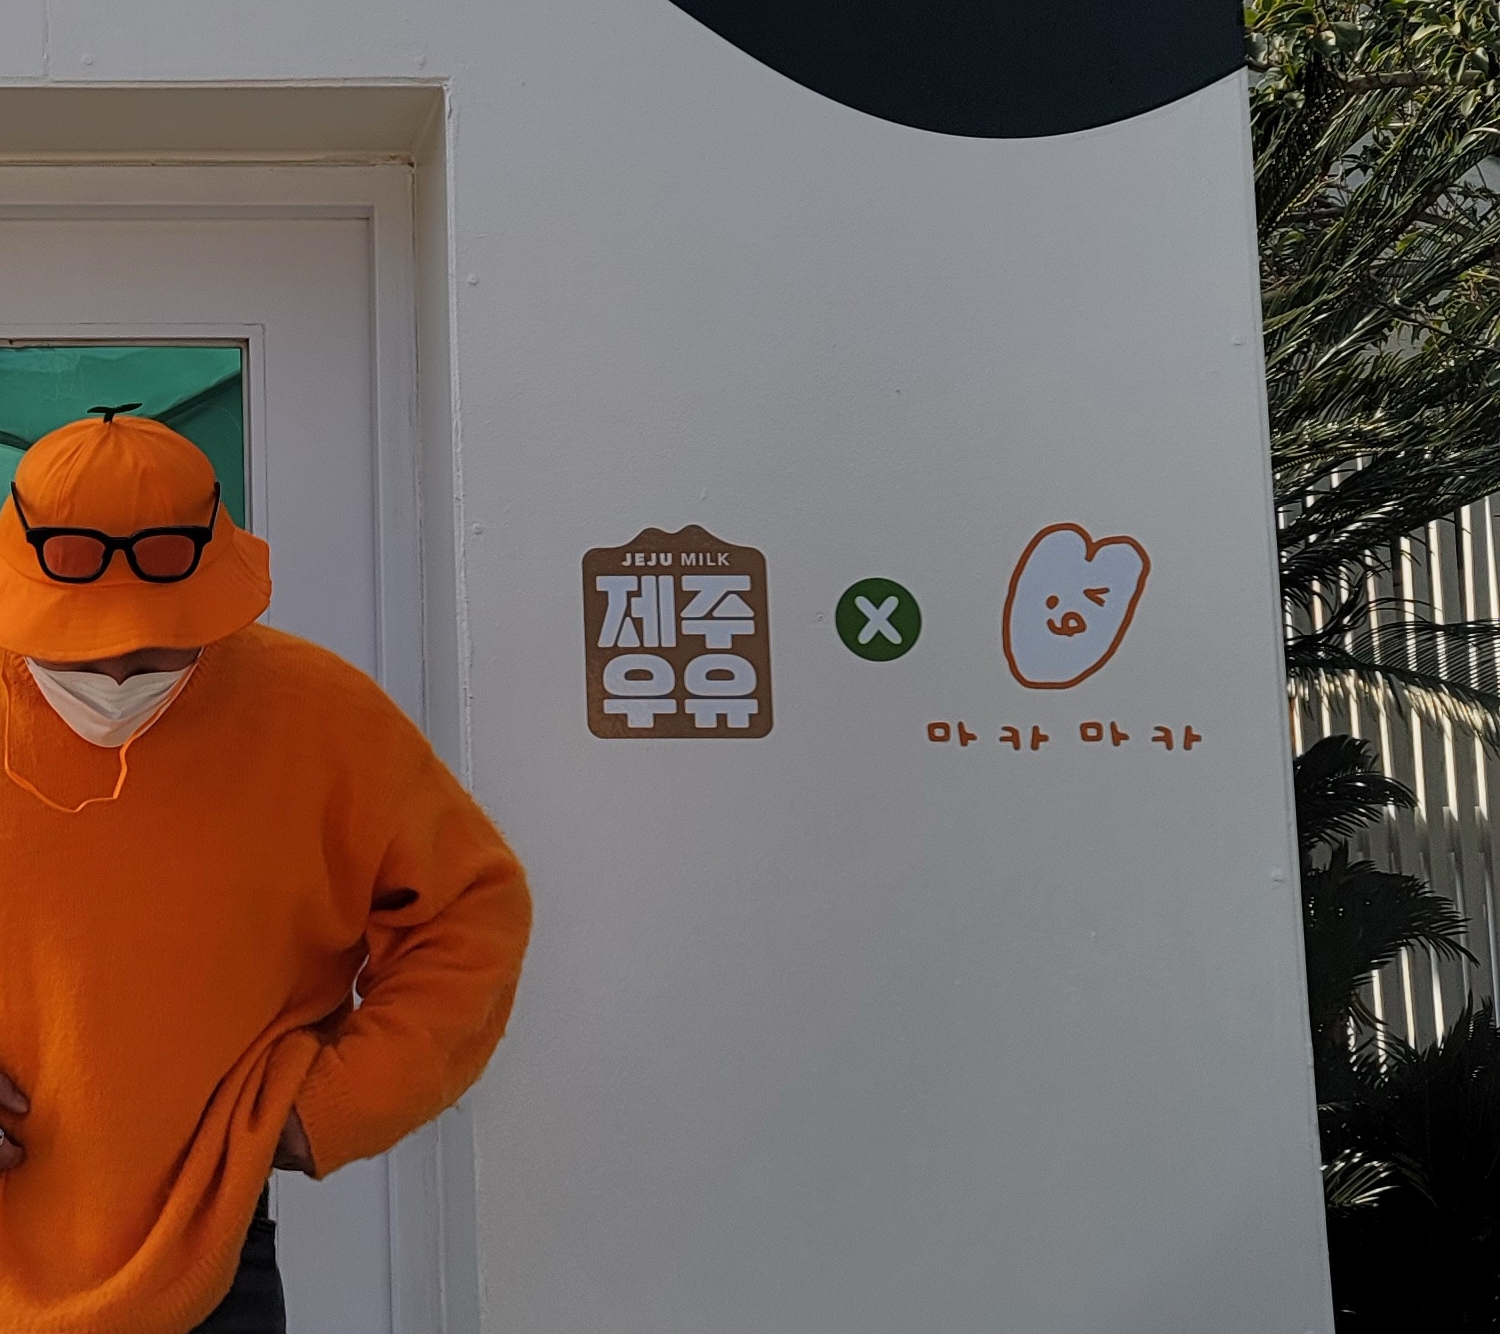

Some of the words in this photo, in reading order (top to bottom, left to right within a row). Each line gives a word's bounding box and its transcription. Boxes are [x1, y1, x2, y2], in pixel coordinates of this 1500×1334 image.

[622, 552, 673, 566] JEJU
[681, 552, 730, 566] MILK
[596, 575, 755, 649] 제주
[603, 654, 758, 728] 우유
